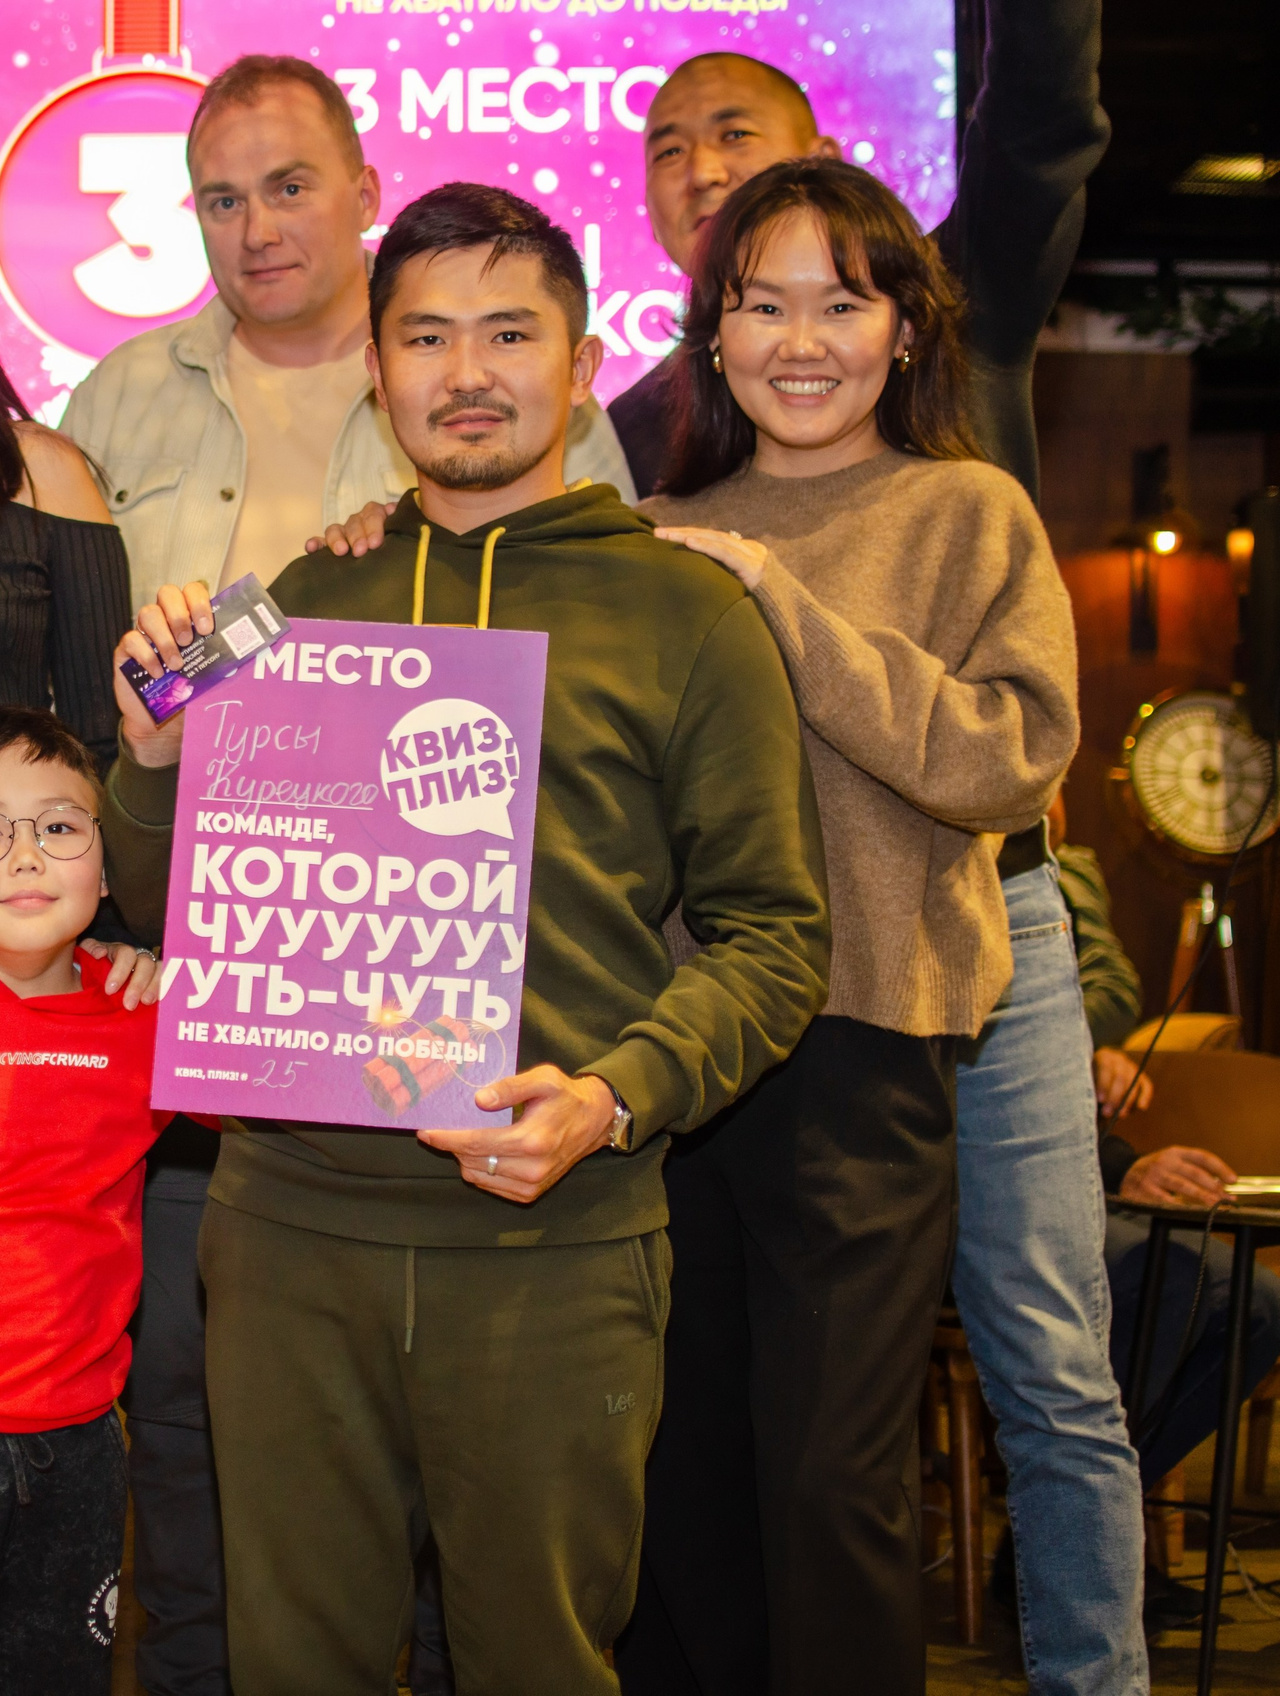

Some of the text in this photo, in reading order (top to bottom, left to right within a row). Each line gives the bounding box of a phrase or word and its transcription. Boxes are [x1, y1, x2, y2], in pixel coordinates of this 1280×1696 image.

[335, 65, 669, 134] 3 МЕСТО
[73, 132, 211, 318] 3
[253, 642, 432, 689] МЕСТО
[204, 700, 322, 764] Турсы
[384, 717, 516, 773] КВИЗ,
[386, 754, 519, 814] ПЛИЗ!
[195, 810, 336, 844] КОМАНДЕ,
[191, 843, 518, 915] КОТОРОЙ
[178, 1020, 486, 1065] НЕ ХВАТИЛО ДО ПОБЕДЫ
[175, 1067, 206, 1080] КВИЗ,
[207, 1070, 239, 1081] ПЛИЗ!
[252, 1059, 309, 1088] 25
[605, 1392, 636, 1415] Lee
